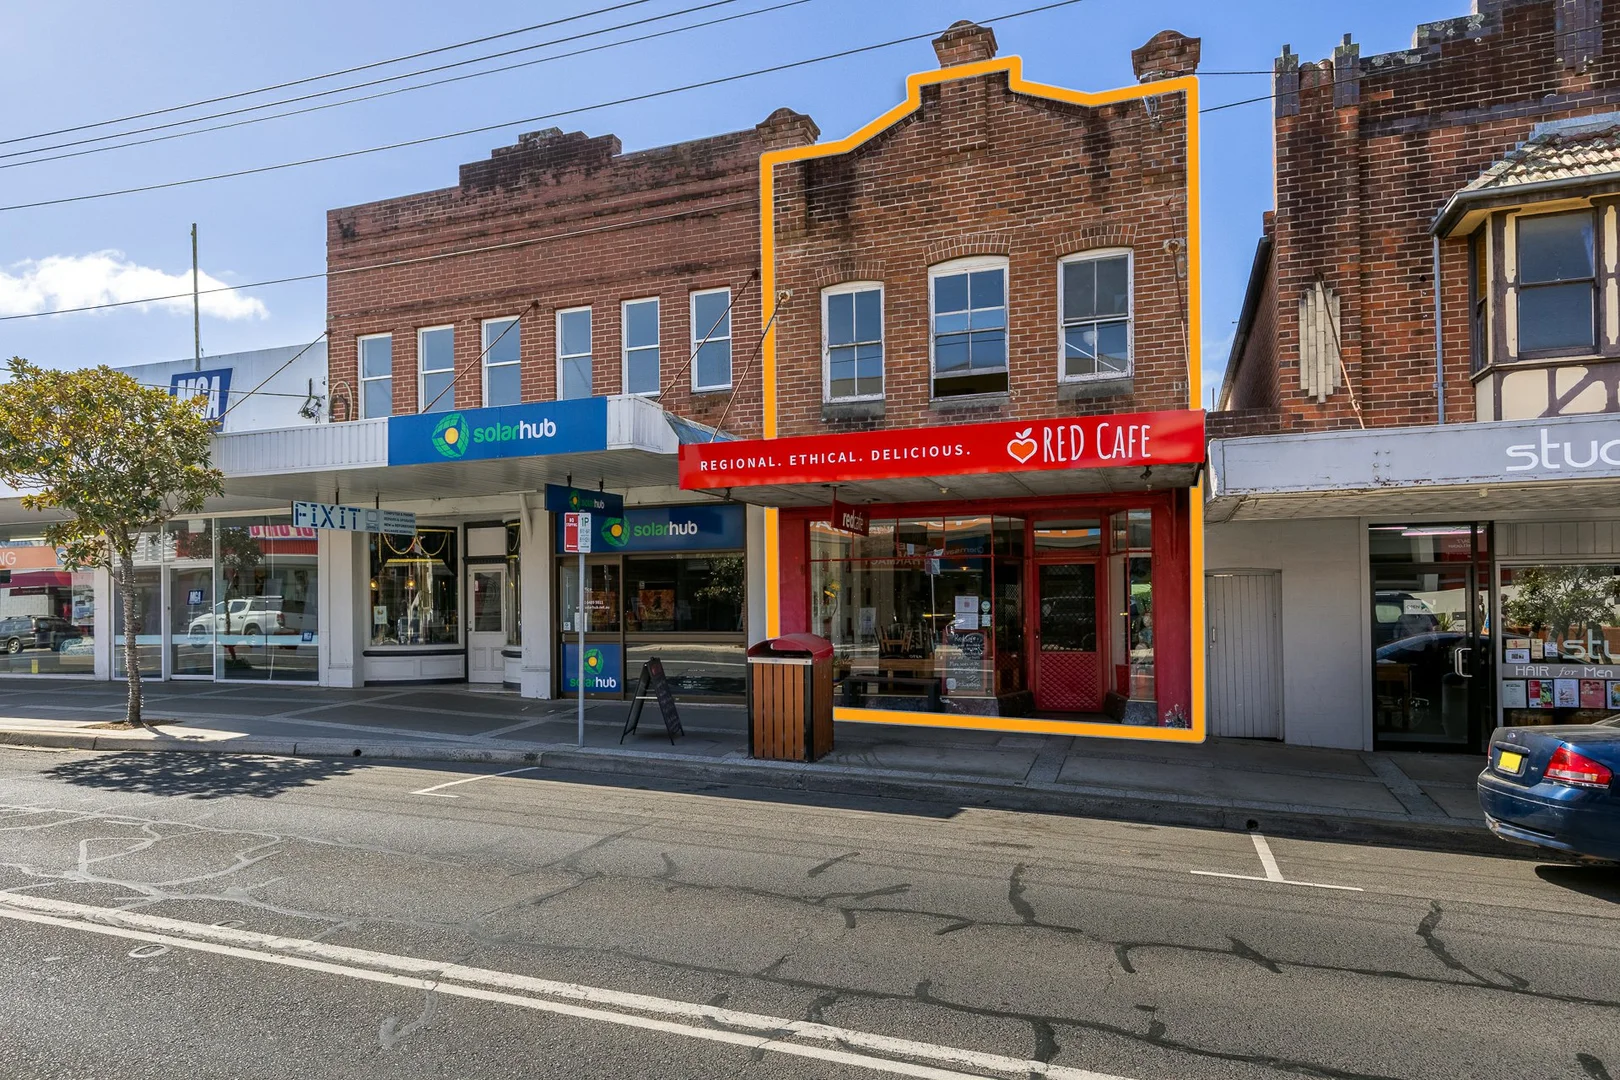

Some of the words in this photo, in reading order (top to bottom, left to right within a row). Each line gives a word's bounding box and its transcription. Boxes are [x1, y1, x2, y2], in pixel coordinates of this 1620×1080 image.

[473, 418, 557, 443] solarhub
[1043, 425, 1084, 463] RED
[700, 456, 784, 472] REGIONAL.
[789, 451, 863, 466] ETHICAL.
[871, 445, 971, 462] DELICIOUS.
[295, 502, 361, 530] FIXIT
[581, 517, 590, 527] 1P
[634, 520, 698, 538] solarhub
[1515, 665, 1550, 677] HAIR
[1553, 667, 1579, 678] for
[1583, 667, 1614, 678] Men
[569, 676, 617, 689] sarhub
